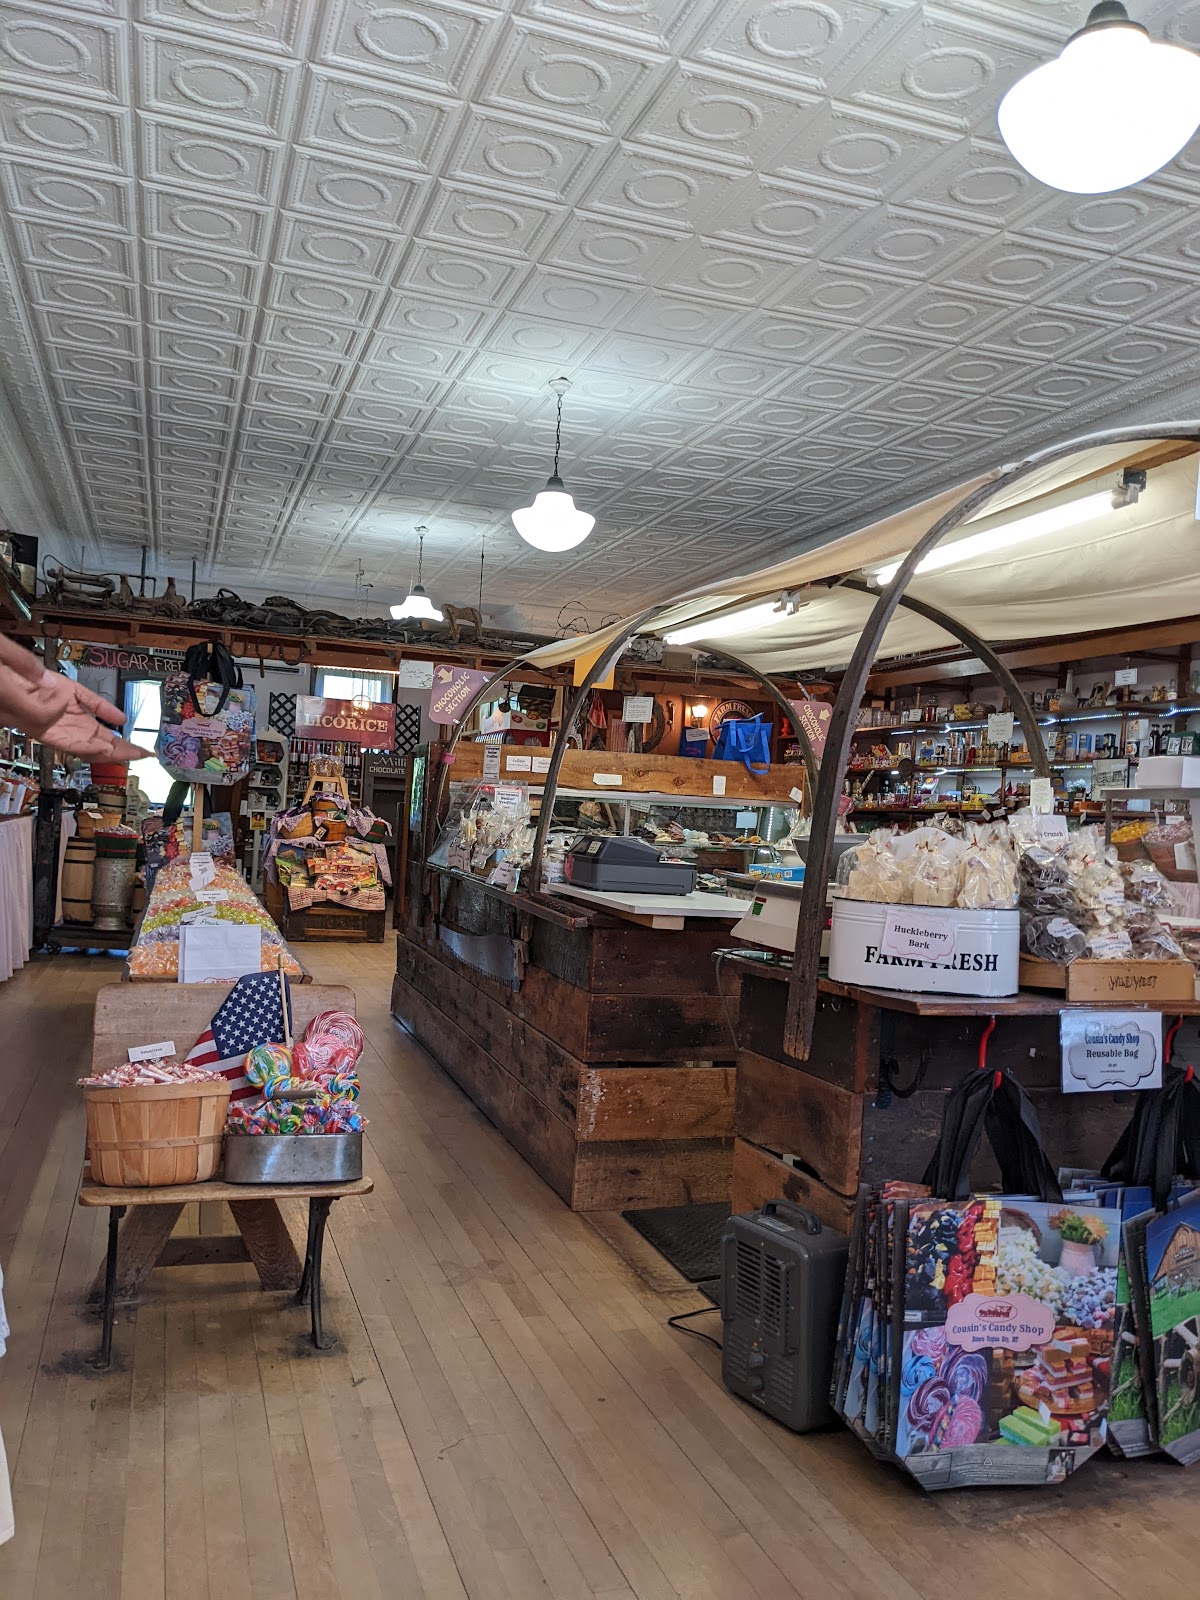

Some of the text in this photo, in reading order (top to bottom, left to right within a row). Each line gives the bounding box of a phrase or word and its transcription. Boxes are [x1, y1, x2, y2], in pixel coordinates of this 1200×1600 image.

[433, 672, 470, 713] CHOCOHOLIC
[445, 686, 472, 715] SECTION
[714, 702, 752, 724] FARM FRES
[303, 713, 388, 733] LICORICE
[799, 714, 817, 742] SECTION
[803, 704, 826, 742] CHOCOHOLIC
[373, 756, 407, 767] Milli
[369, 766, 405, 775] CHOCOLATE
[894, 925, 949, 941] Huckleberry
[908, 939, 930, 950] Bark
[1085, 1033, 1140, 1046] Cousin's Candy Shop
[1086, 1049, 1139, 1059] Reusable Bag
[952, 1323, 1044, 1336] Cousin's Candy Shop
